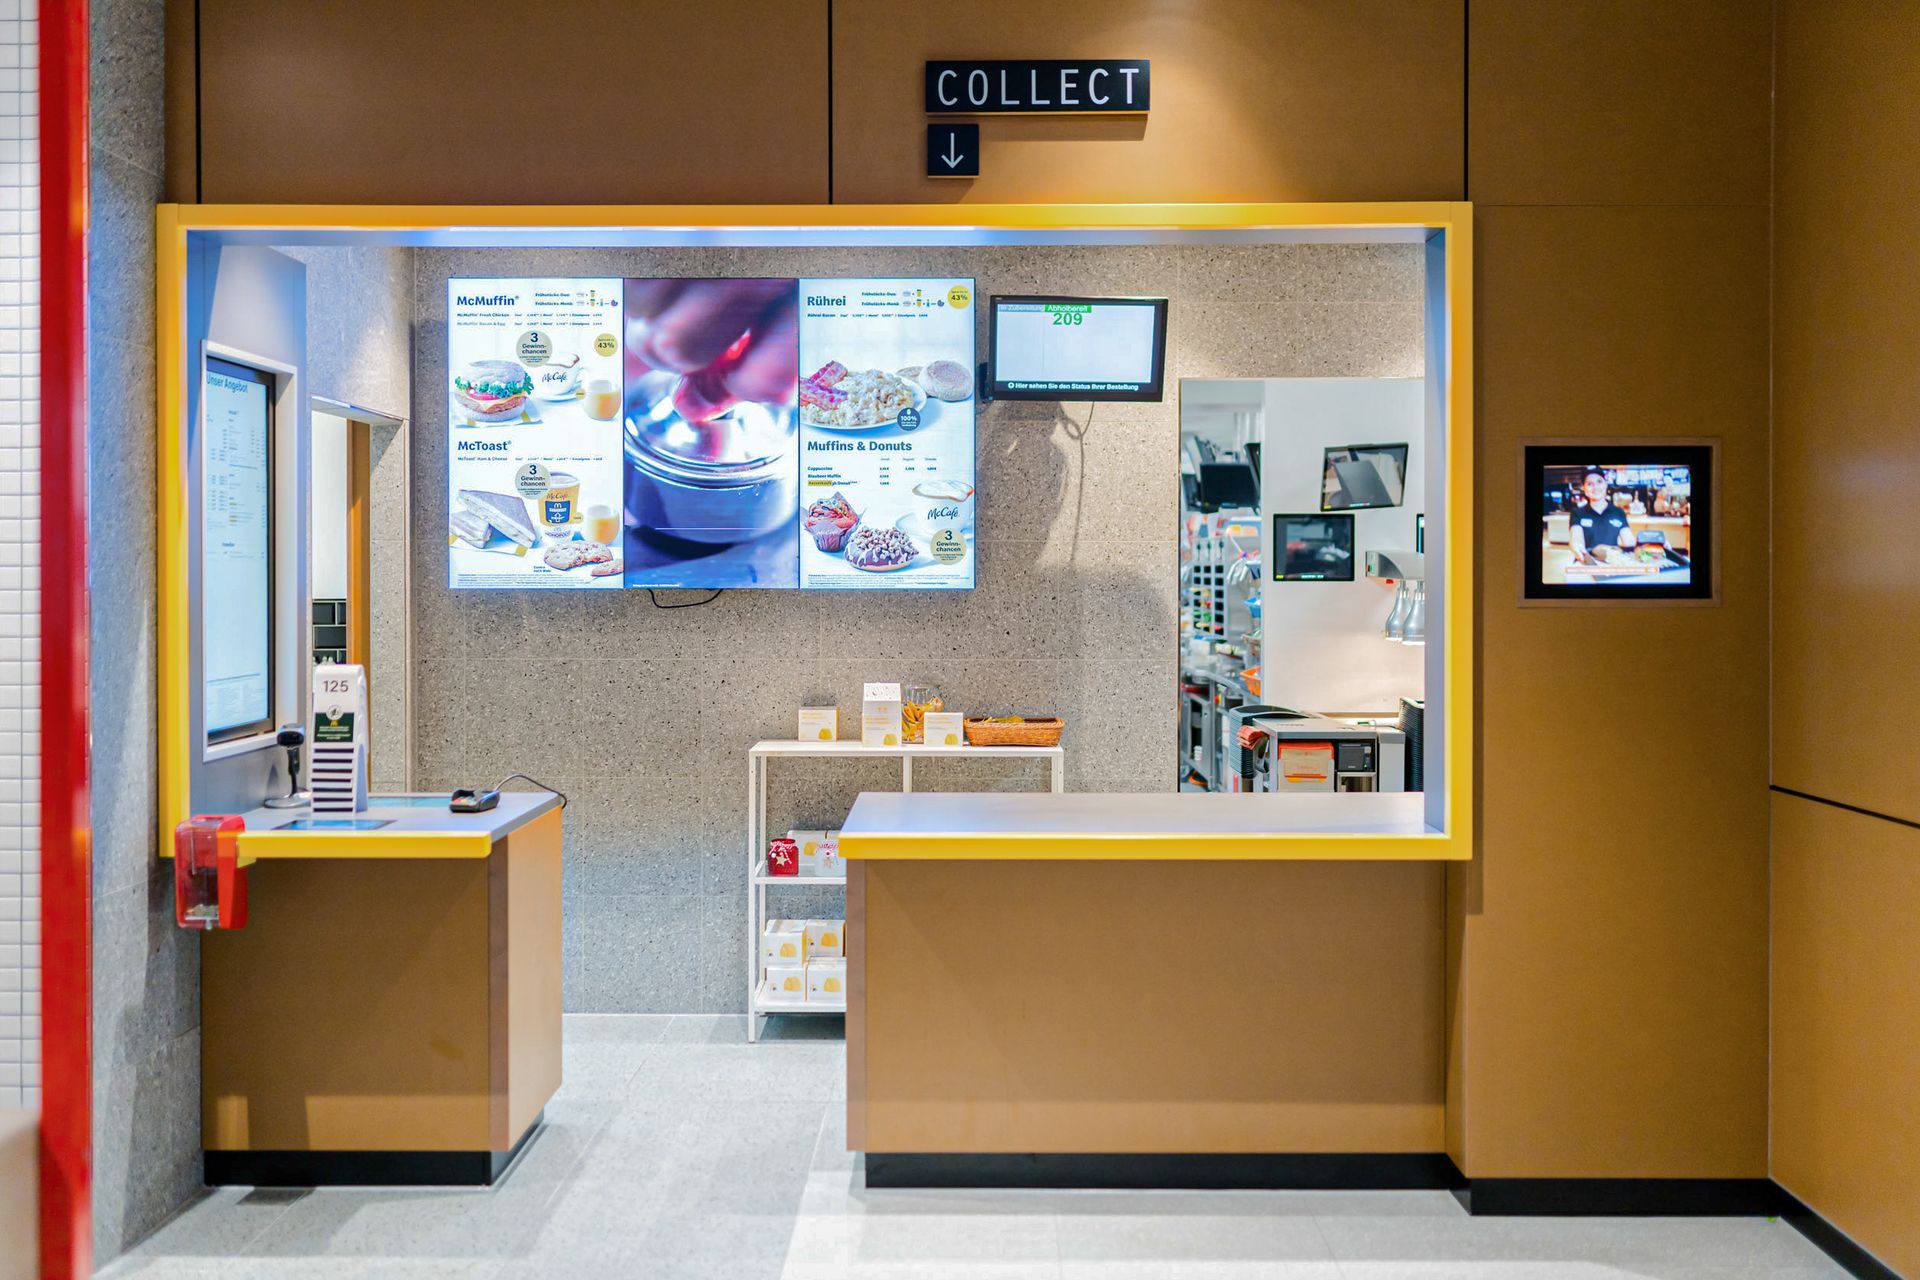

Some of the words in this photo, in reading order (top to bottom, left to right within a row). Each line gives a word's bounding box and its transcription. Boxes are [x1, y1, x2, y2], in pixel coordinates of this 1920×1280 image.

[937, 68, 1140, 106] COLLECT
[807, 296, 846, 306] Rührei
[1052, 312, 1083, 326] 209
[530, 332, 538, 342] 3
[807, 441, 854, 451] Muffins
[857, 441, 866, 451] &
[869, 441, 912, 451] Donuts
[529, 465, 537, 475] 3
[927, 506, 959, 520] McCafé
[945, 530, 953, 540] 3
[323, 680, 349, 693] 125
